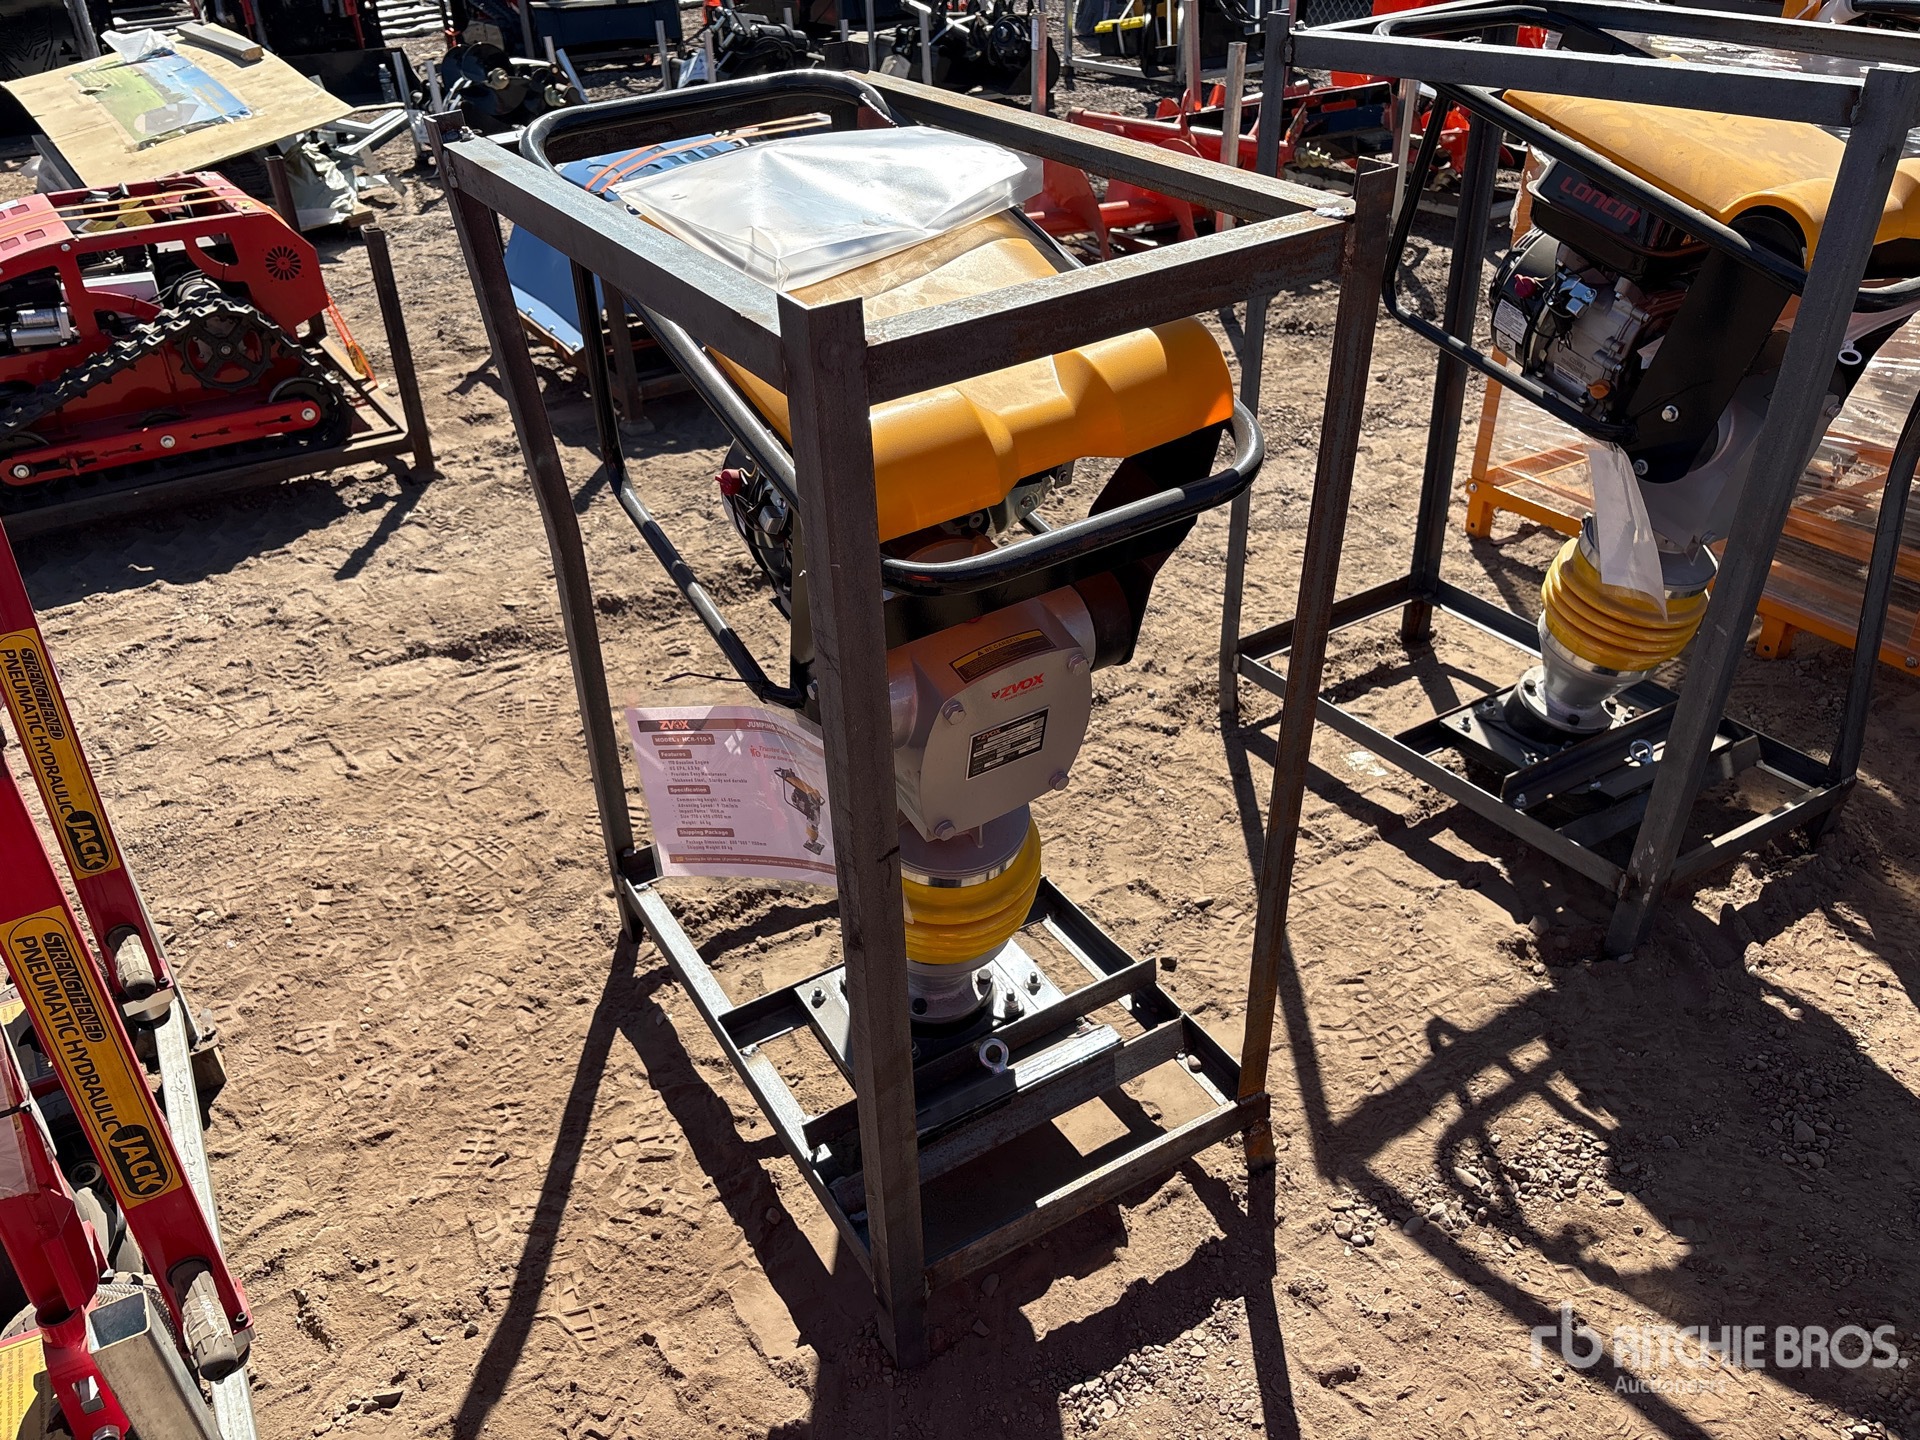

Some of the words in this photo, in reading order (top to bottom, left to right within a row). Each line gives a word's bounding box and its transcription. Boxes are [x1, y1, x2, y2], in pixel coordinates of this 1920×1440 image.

[1559, 176, 1641, 226] LONCIN
[19, 647, 65, 740] STRENGTHENED
[1000, 672, 1045, 699] ZVOX
[4, 649, 43, 735] PNEUMATIC
[33, 735, 75, 815] HYDRAULIC
[67, 819, 106, 868] JACK
[41, 932, 107, 1043] STRENGTHENED
[15, 937, 79, 1039] PNEUMATIC
[63, 1038, 121, 1133] HYDRAULIC
[109, 1135, 164, 1195] JACK
